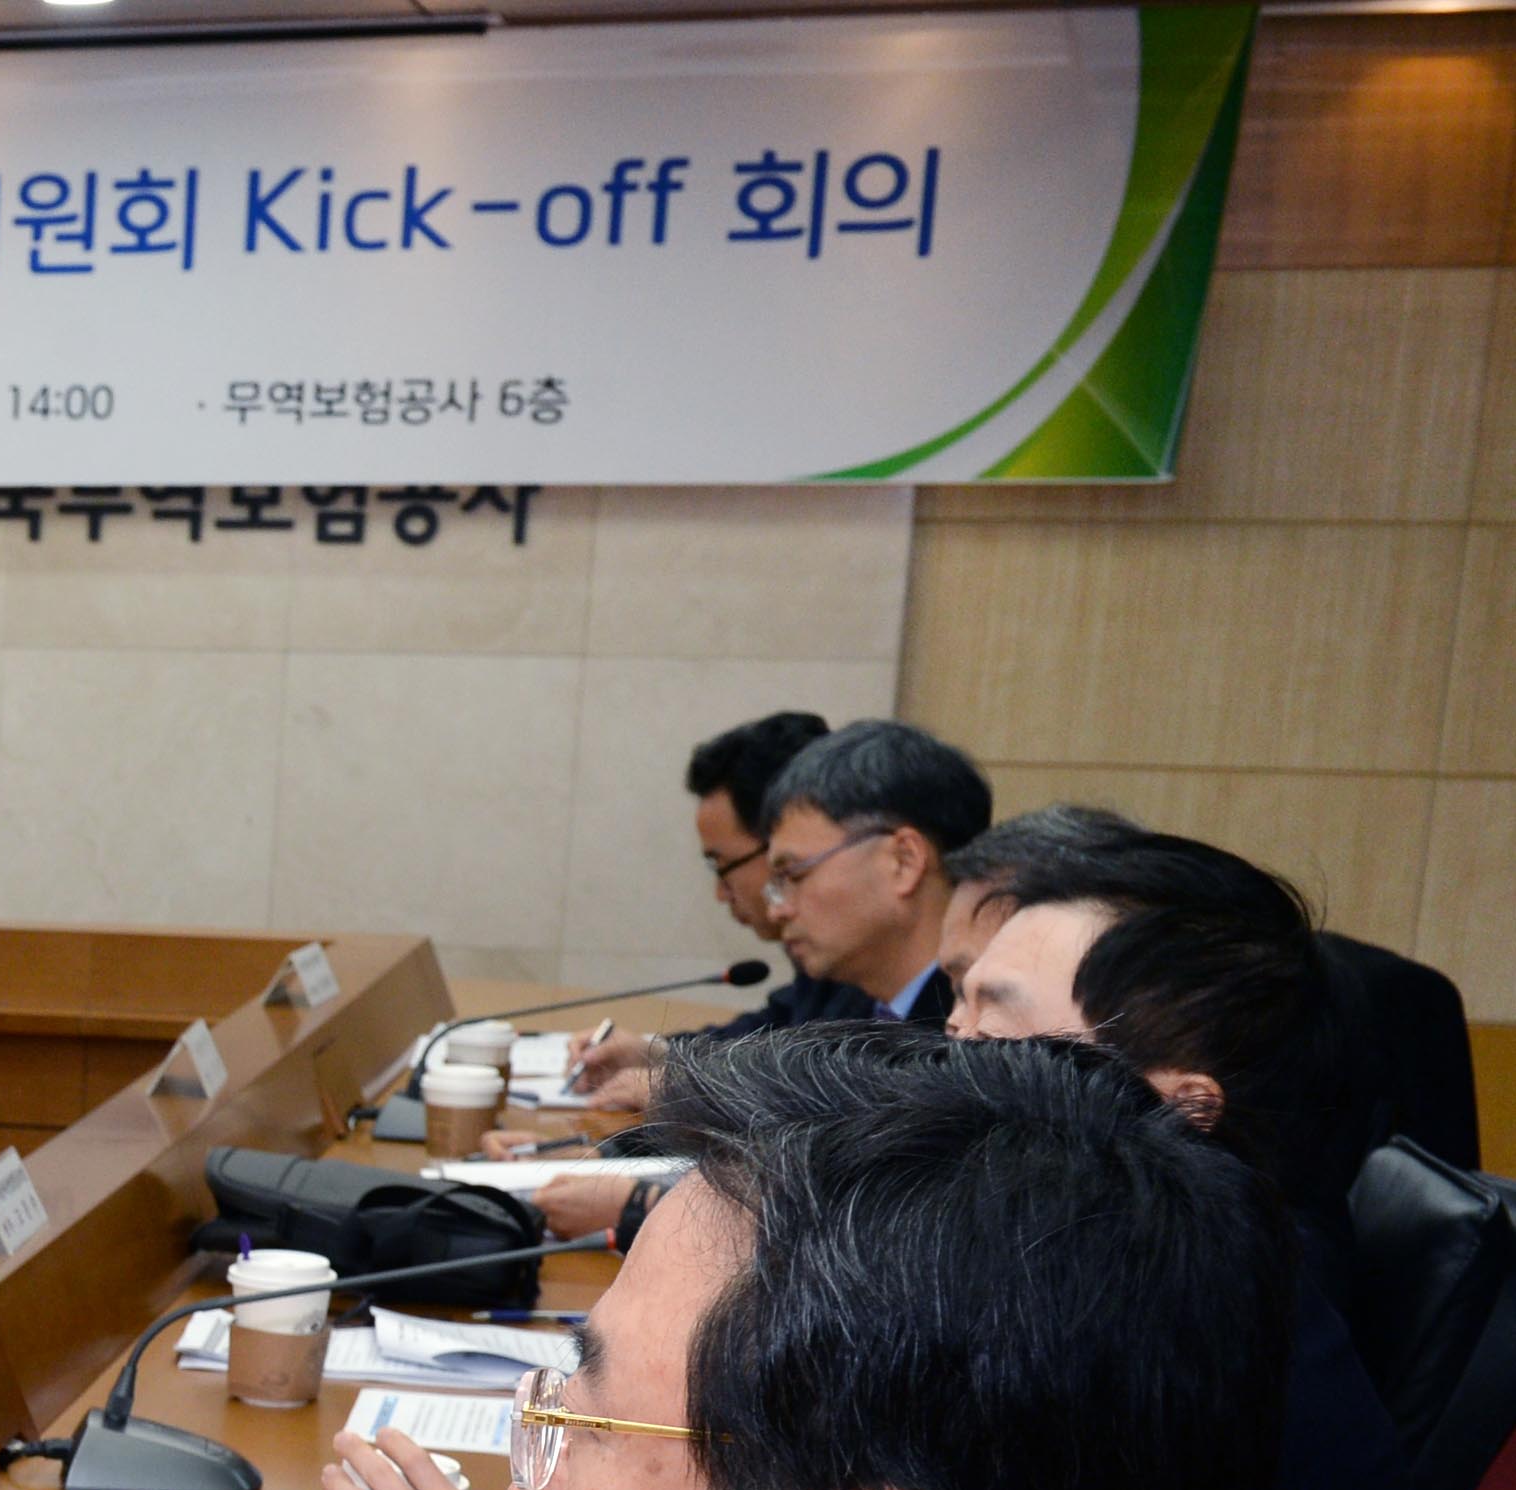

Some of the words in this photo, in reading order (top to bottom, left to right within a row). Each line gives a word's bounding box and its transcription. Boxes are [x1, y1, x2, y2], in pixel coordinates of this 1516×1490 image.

[243, 157, 690, 254] Kick-off
[727, 146, 941, 260] 회의
[8, 384, 115, 421] 14:00
[223, 379, 481, 424] 무역보험공사
[498, 376, 570, 424] 6층
